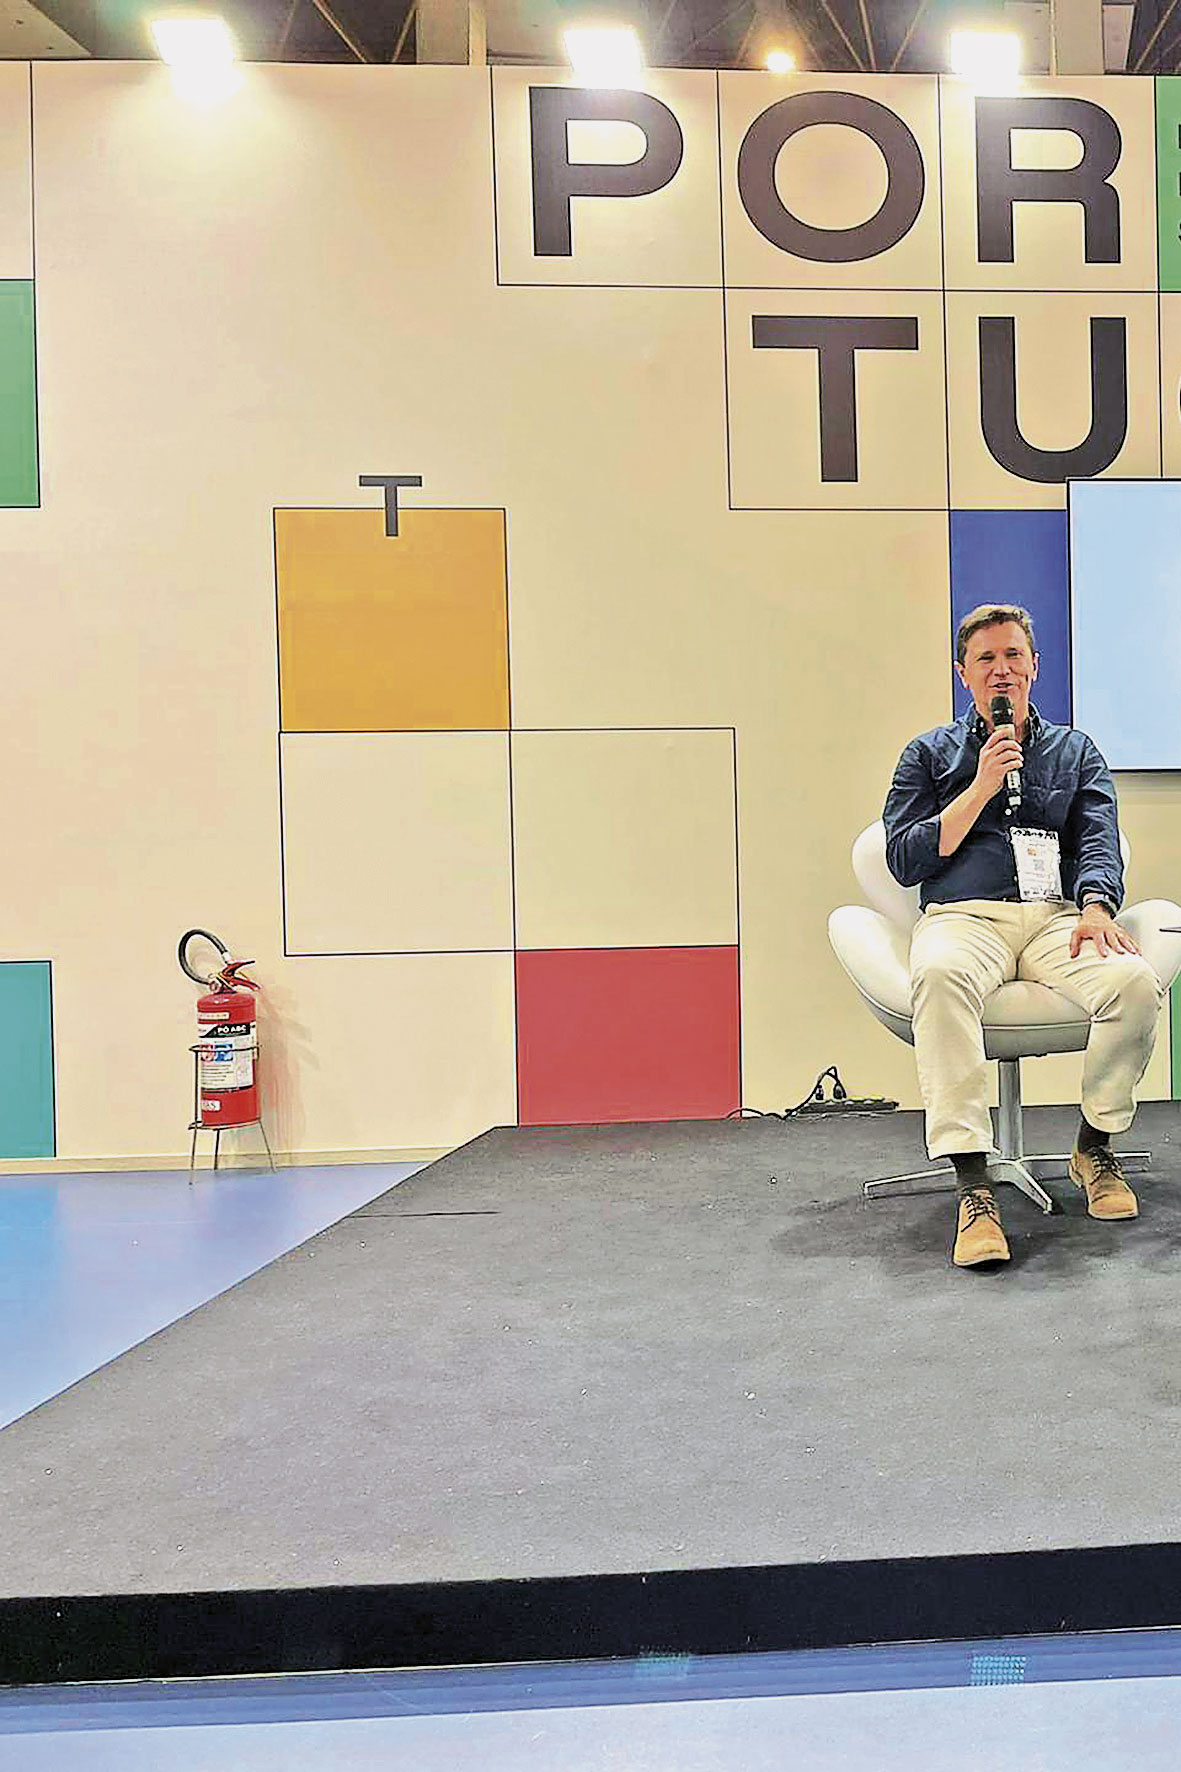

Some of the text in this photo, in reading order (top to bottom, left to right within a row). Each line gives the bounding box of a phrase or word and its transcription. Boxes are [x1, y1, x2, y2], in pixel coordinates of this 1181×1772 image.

[528, 86, 1122, 263] POR
[359, 475, 422, 537] T
[230, 1024, 247, 1033] ABC
